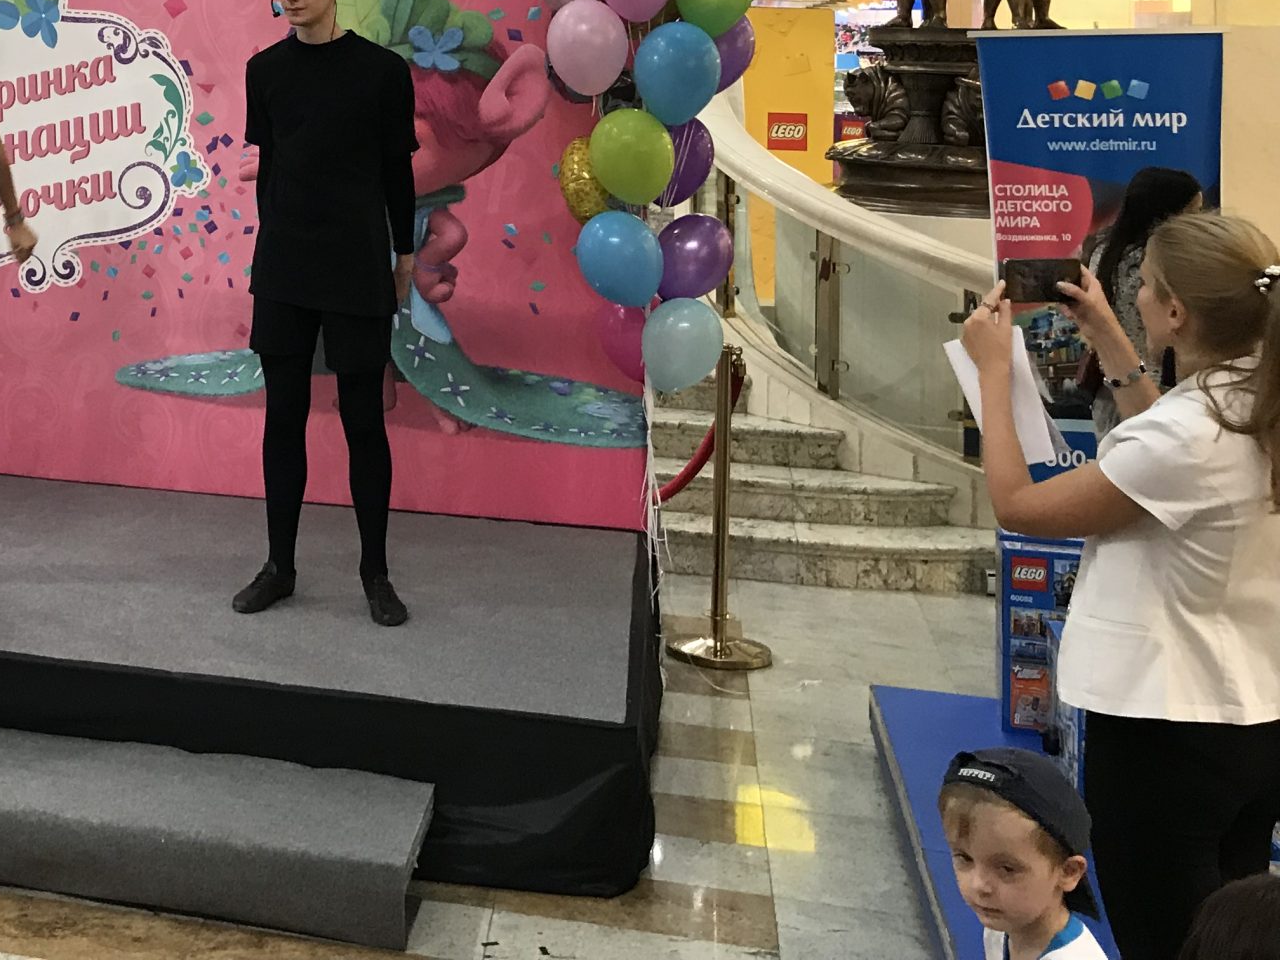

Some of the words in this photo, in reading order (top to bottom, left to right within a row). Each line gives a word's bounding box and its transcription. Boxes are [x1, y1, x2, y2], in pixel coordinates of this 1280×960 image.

[1016, 107, 1124, 129] Детский
[1132, 111, 1187, 134] мир
[770, 123, 805, 139] LEGO
[842, 126, 863, 136] LEGO
[1047, 138, 1157, 151] www.detmir.ru
[995, 183, 1069, 198] СТОЛИЦА
[995, 200, 1072, 214] ДЕТСКОГО
[996, 216, 1040, 228] МИРА
[1062, 233, 1072, 241] 10
[1013, 565, 1047, 582] LEGO
